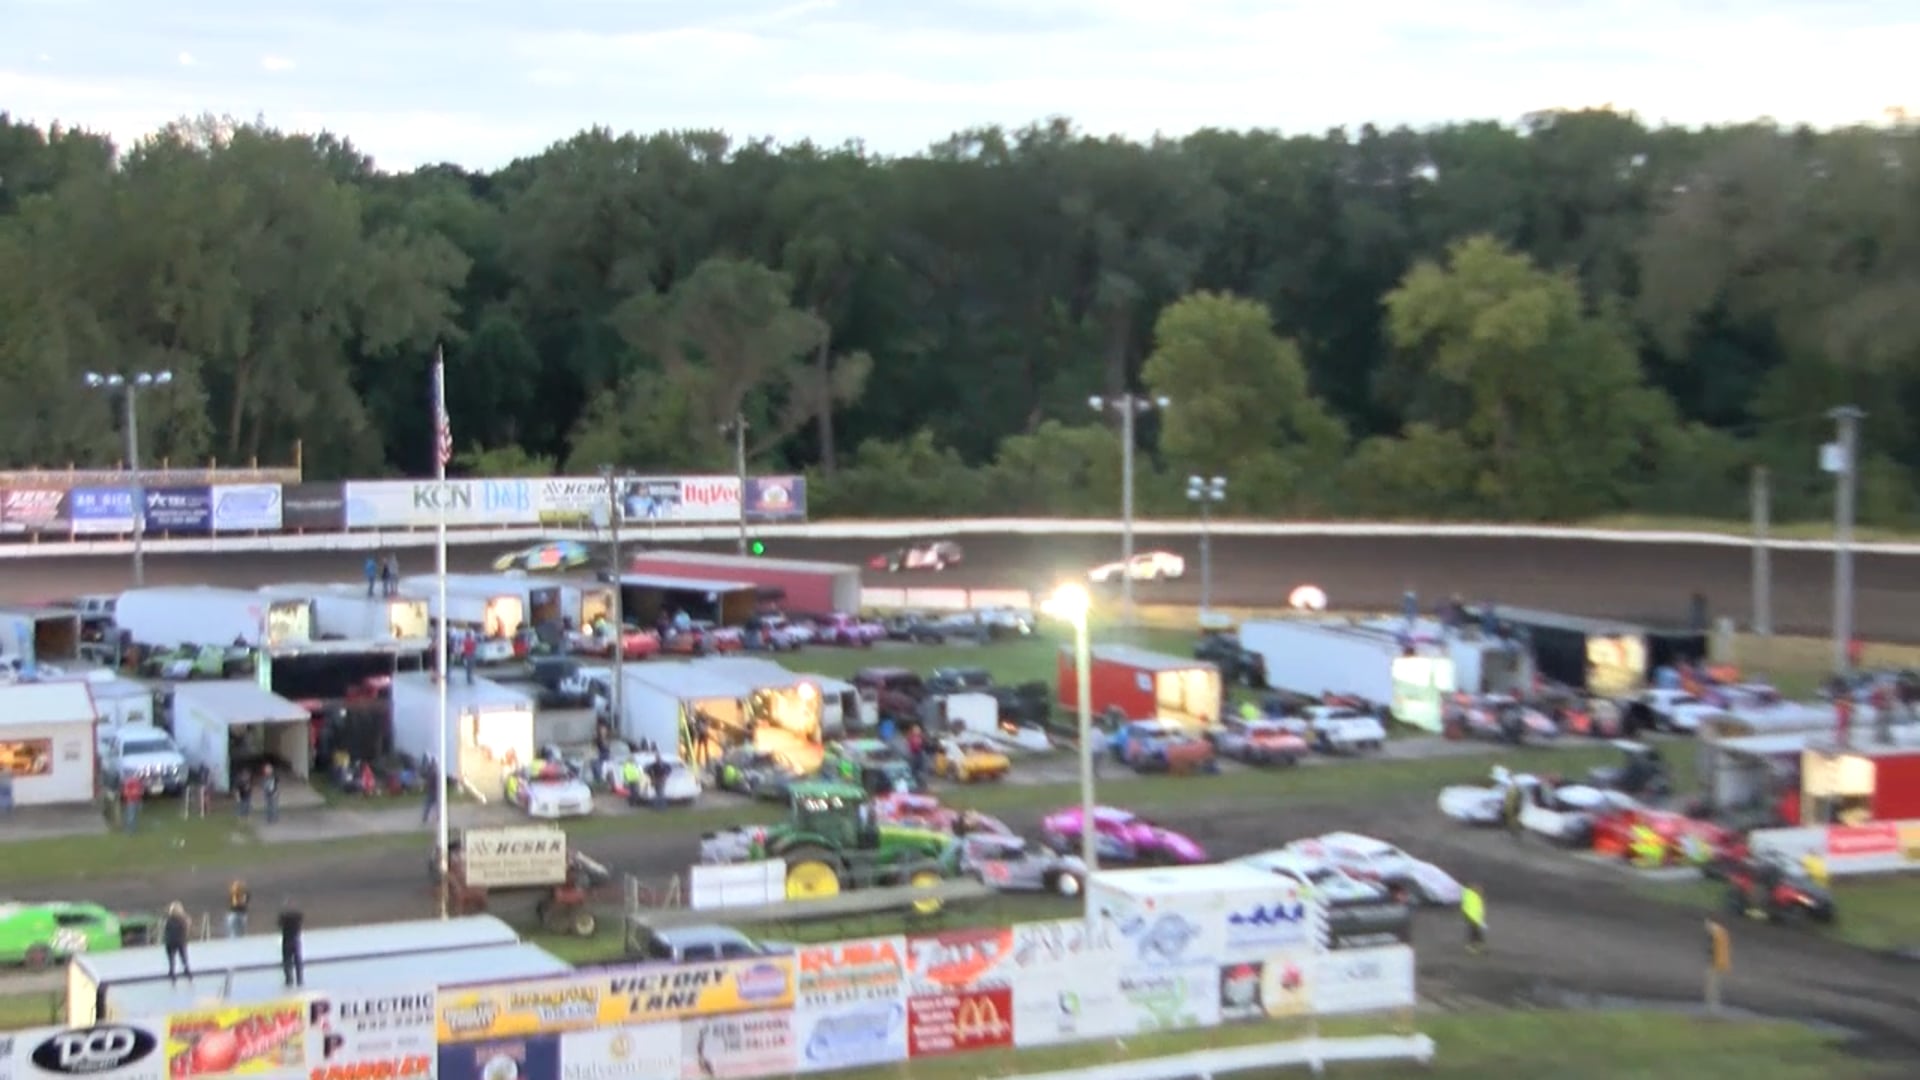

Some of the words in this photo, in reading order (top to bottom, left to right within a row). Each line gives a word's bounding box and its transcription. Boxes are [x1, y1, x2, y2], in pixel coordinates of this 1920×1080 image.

[413, 483, 472, 510] KCN
[610, 966, 724, 996] VICTORY
[339, 993, 434, 1020] ELECTRIC
[629, 990, 697, 1014] LANE
